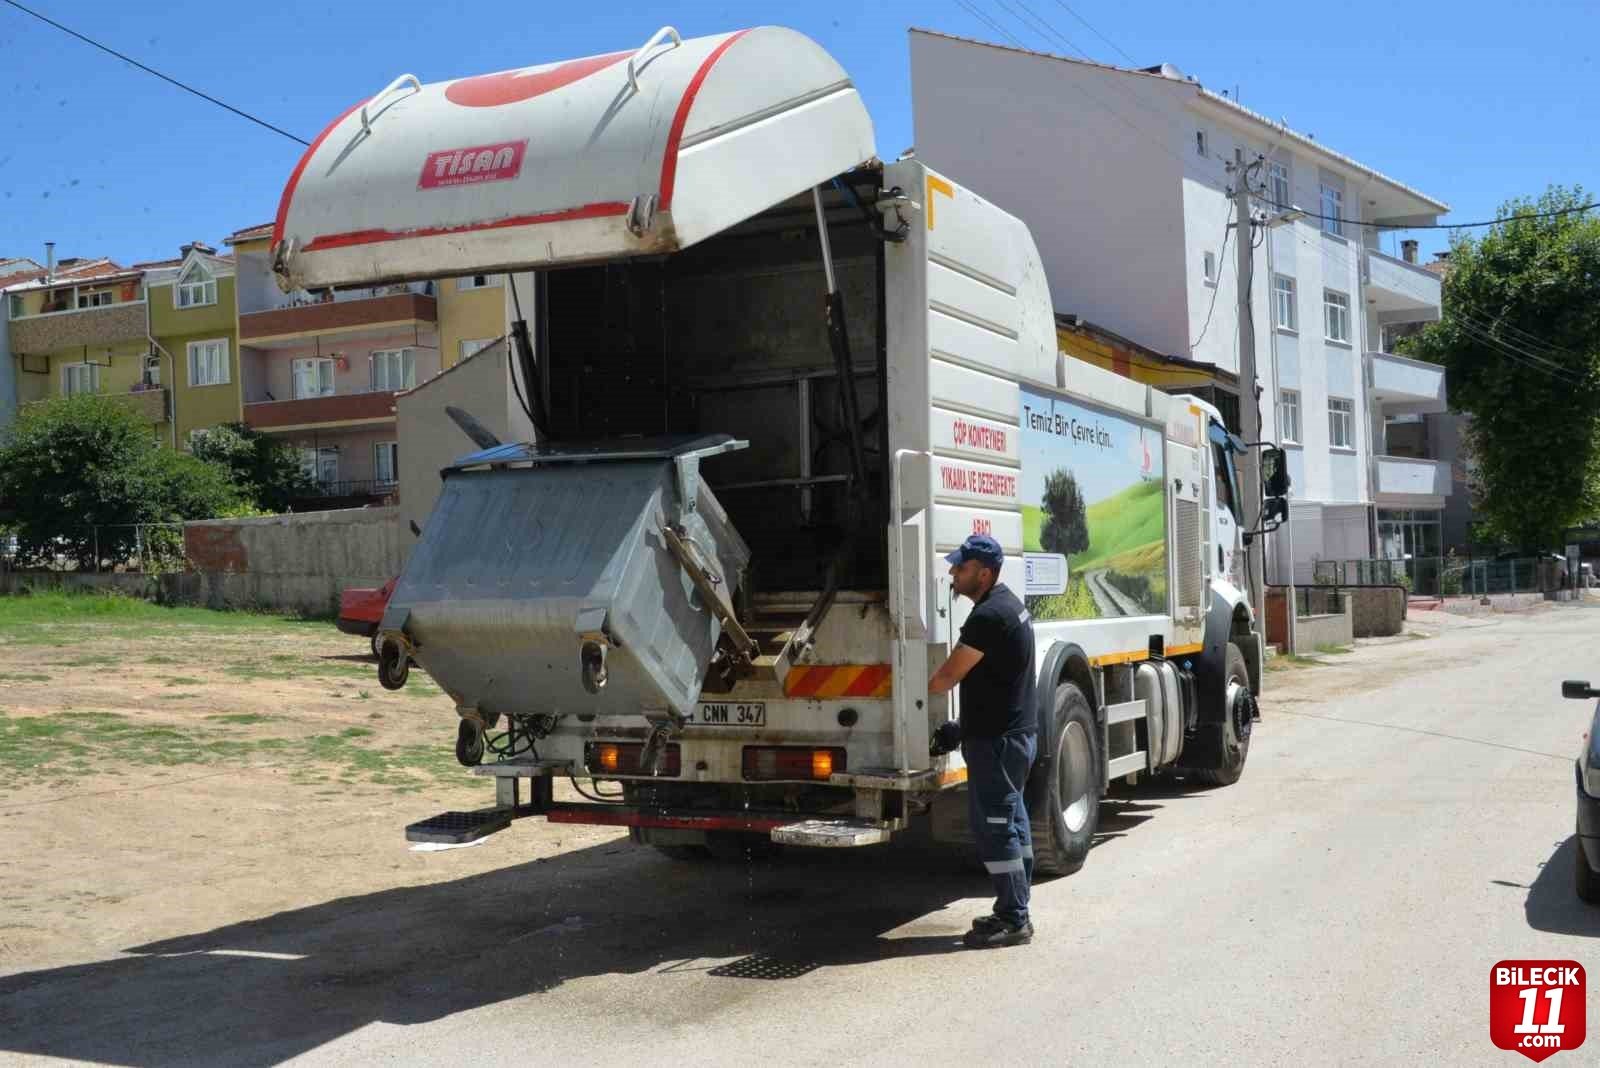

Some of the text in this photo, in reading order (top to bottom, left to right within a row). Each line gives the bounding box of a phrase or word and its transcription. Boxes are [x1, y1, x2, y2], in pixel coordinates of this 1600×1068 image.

[1024, 405, 1053, 433] Temiz
[1055, 414, 1069, 436] Bir
[1071, 418, 1095, 446] Çevre
[941, 465, 1016, 497] YIKAMA VE DEZENFEKTE
[703, 704, 729, 723] CNN
[737, 705, 763, 723] 347
